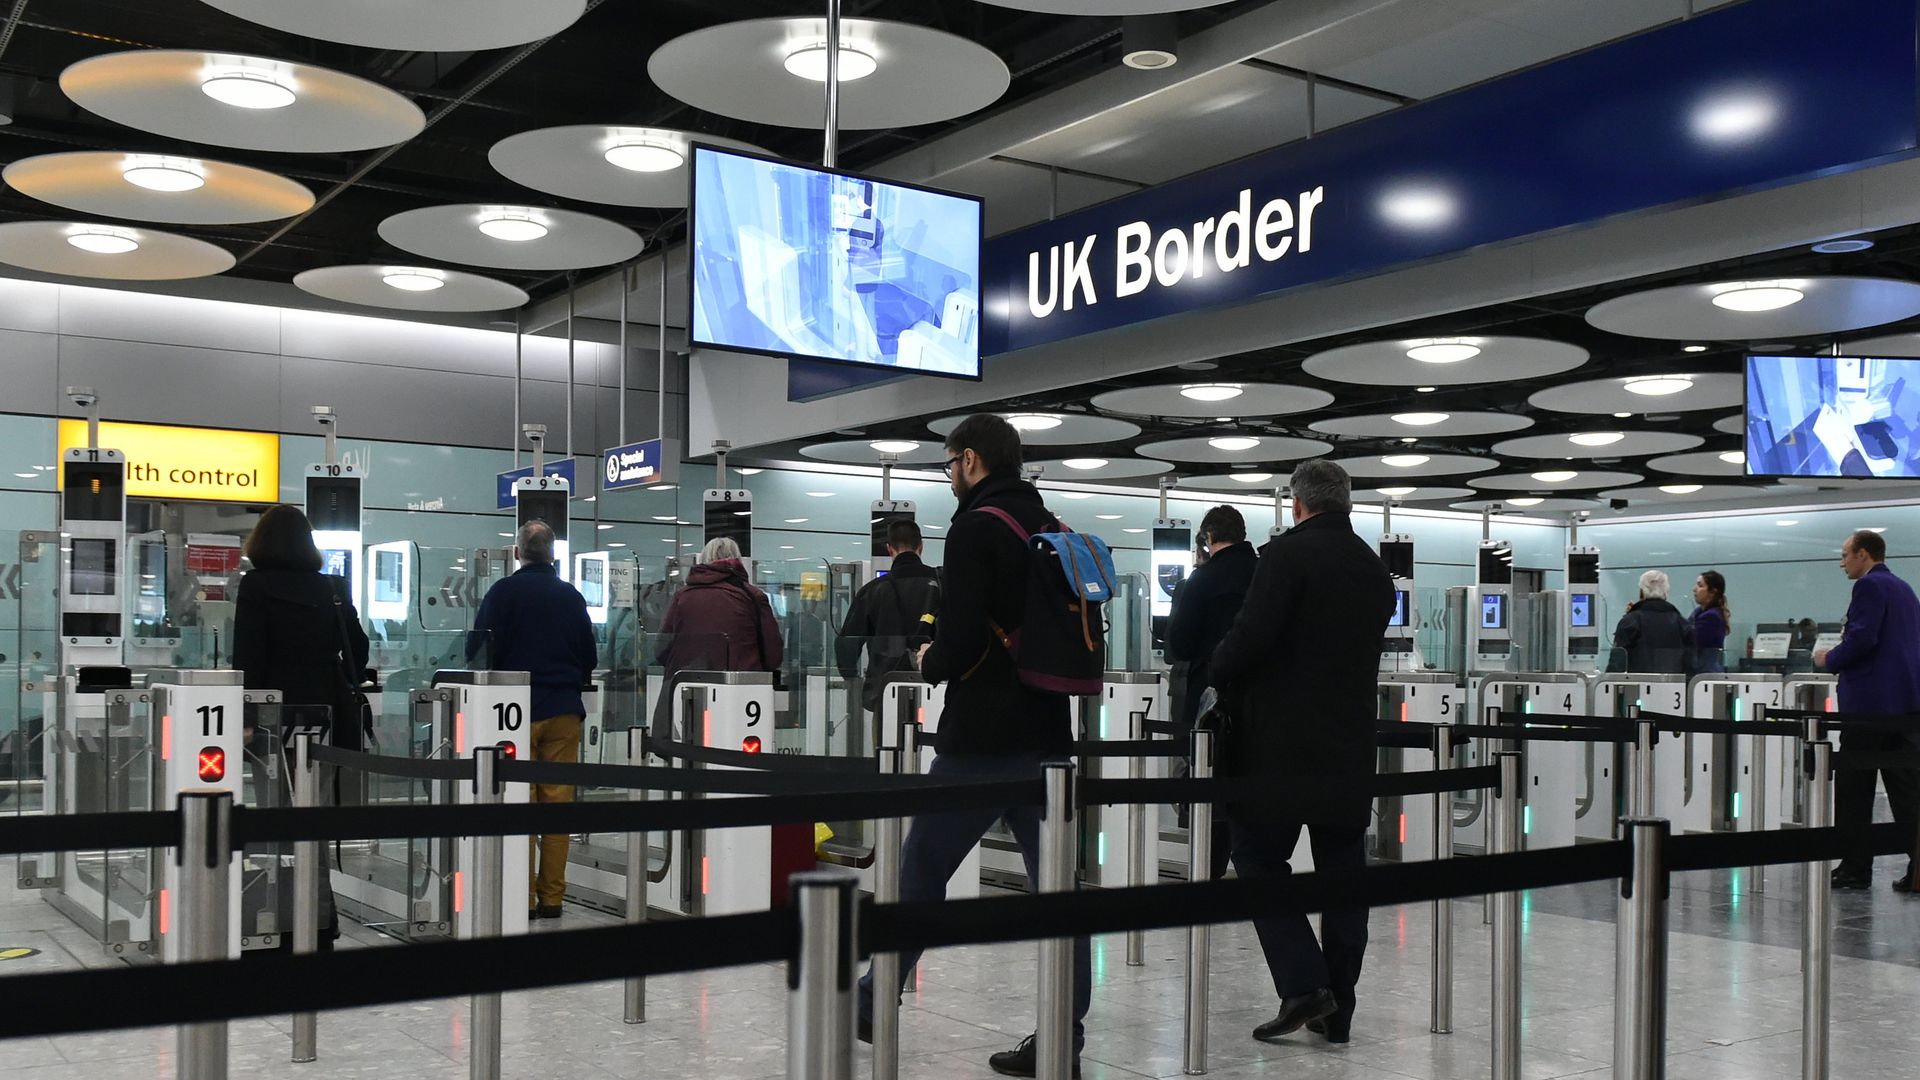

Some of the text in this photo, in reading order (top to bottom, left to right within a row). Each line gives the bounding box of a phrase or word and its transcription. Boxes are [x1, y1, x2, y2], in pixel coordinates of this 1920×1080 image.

[1028, 185, 1324, 318] UK Border
[87, 449, 99, 461] 11
[127, 461, 258, 487] lth control
[326, 464, 341, 477] 10
[539, 478, 548, 490] 9
[724, 490, 732, 501] 8
[891, 501, 898, 512] 7
[1170, 519, 1176, 529] 5
[1441, 694, 1450, 715] 5
[1563, 693, 1572, 712] 4
[1673, 691, 1681, 710] 3
[1772, 689, 1779, 706] 2
[492, 702, 523, 731] 10
[745, 700, 761, 728] 9
[1141, 696, 1153, 719] 7
[196, 705, 224, 737] 11
